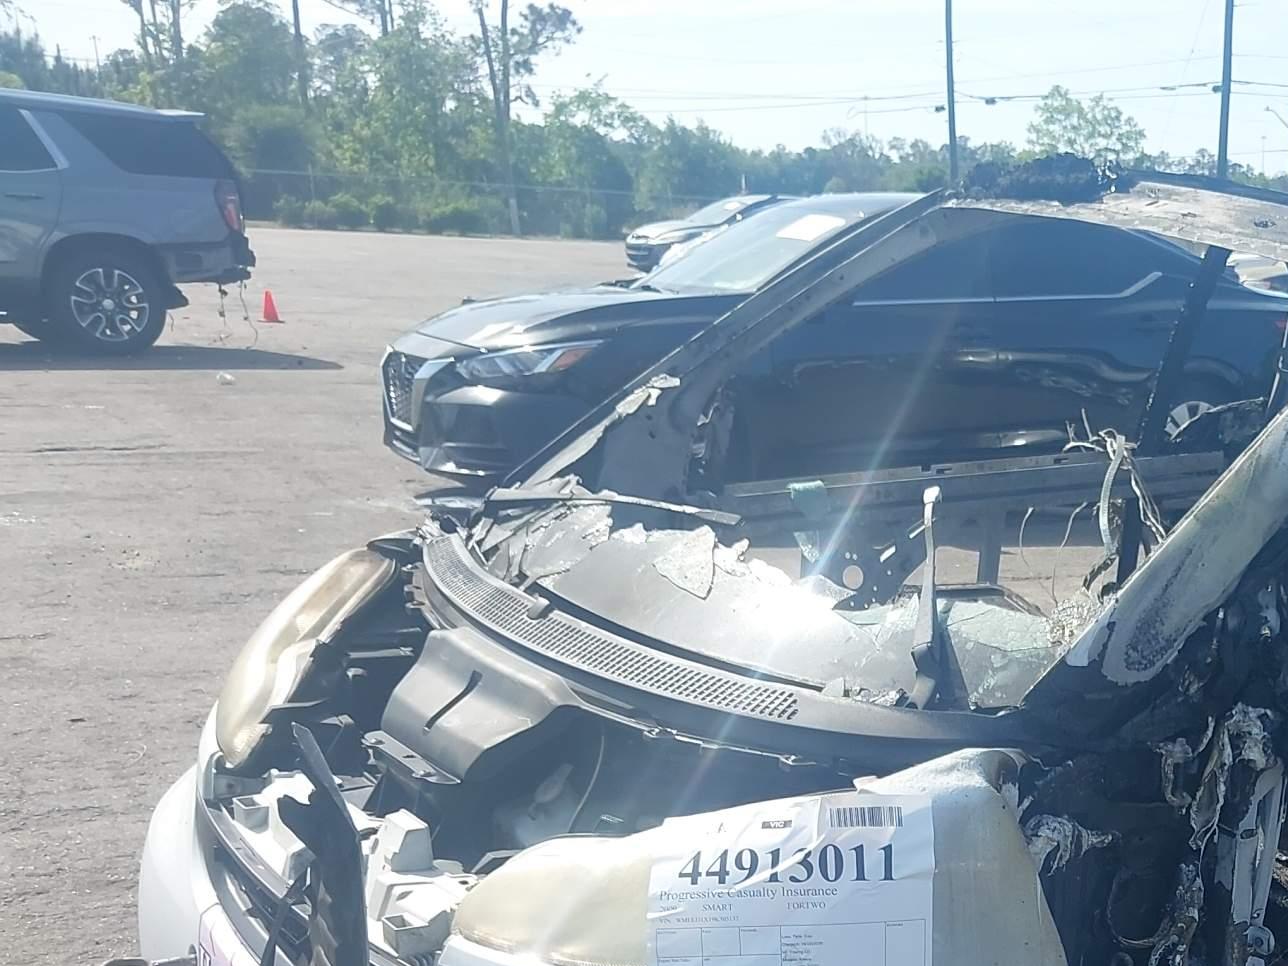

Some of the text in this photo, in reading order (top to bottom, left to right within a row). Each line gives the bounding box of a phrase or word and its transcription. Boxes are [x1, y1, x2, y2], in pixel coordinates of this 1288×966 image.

[678, 842, 897, 886] 44913011
[660, 886, 838, 902] Progressive Casualty Insurance
[702, 903, 733, 912] SMART
[787, 901, 826, 911] FORTWO
